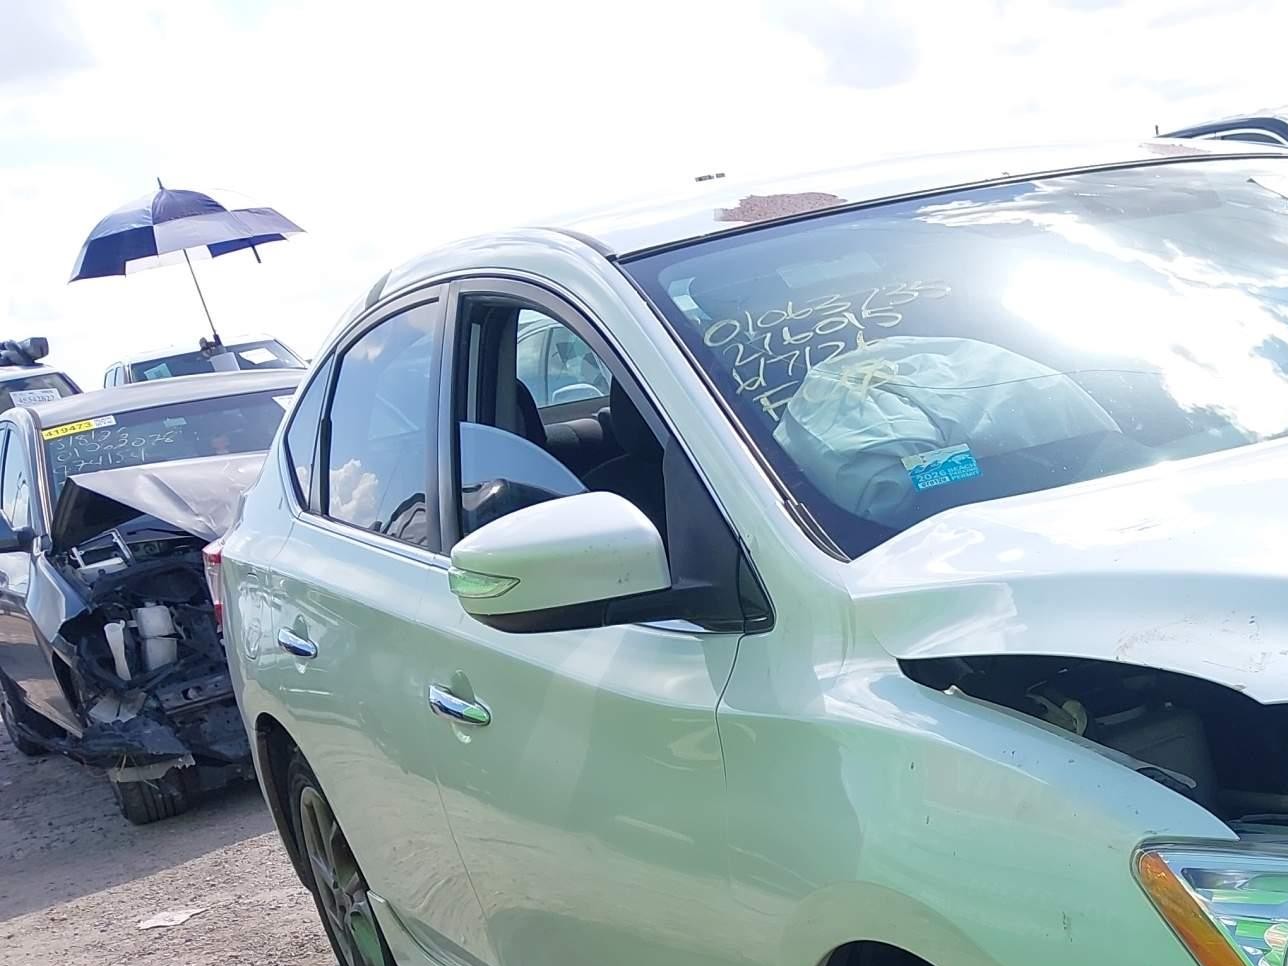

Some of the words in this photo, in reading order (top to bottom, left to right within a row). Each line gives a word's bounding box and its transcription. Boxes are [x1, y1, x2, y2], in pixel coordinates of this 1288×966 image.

[947, 463, 977, 473] BEACH
[919, 469, 947, 482] 2026
[952, 471, 980, 481] PERMIT
